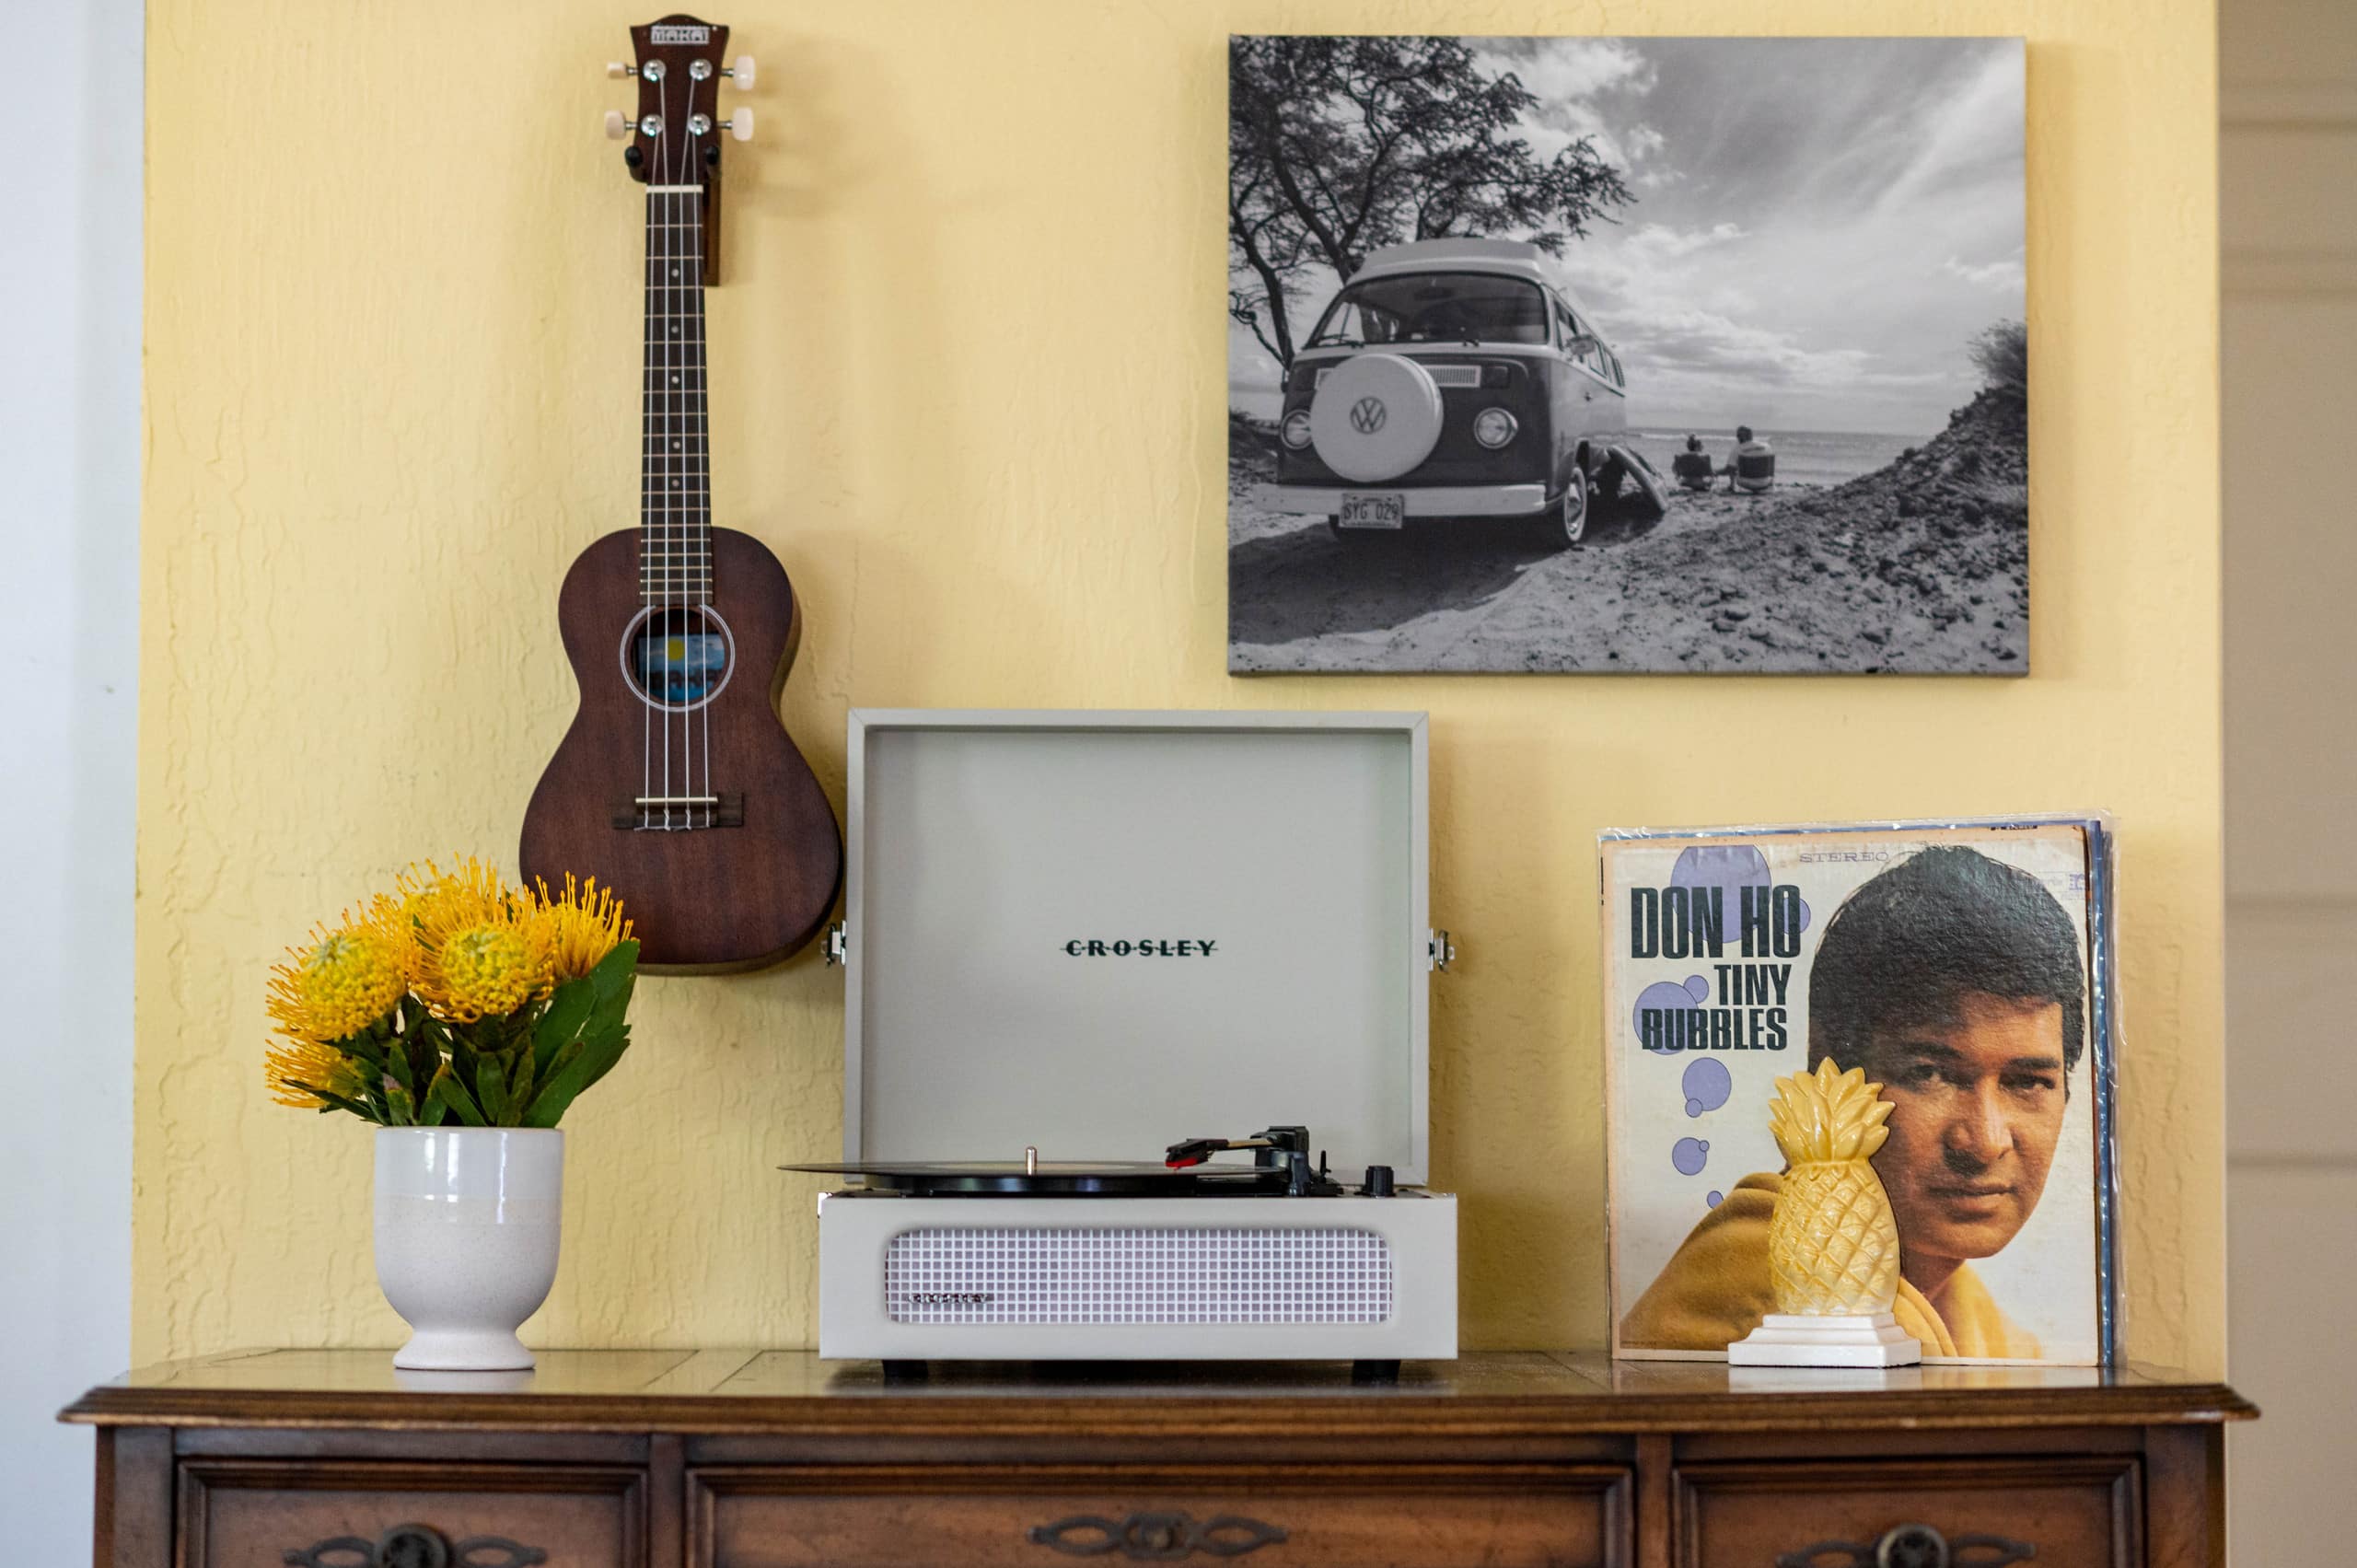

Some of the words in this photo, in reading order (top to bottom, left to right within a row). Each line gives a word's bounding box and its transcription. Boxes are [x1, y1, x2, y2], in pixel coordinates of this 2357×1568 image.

[1344, 503, 1368, 520] SYG
[1799, 852, 1888, 863] STEREO
[1631, 886, 1724, 958] DON
[1740, 885, 1802, 958] HO
[1061, 939, 1218, 957] CROSLEY
[1713, 964, 1792, 1005] TINY
[1641, 1008, 1788, 1051] BUBBLES
